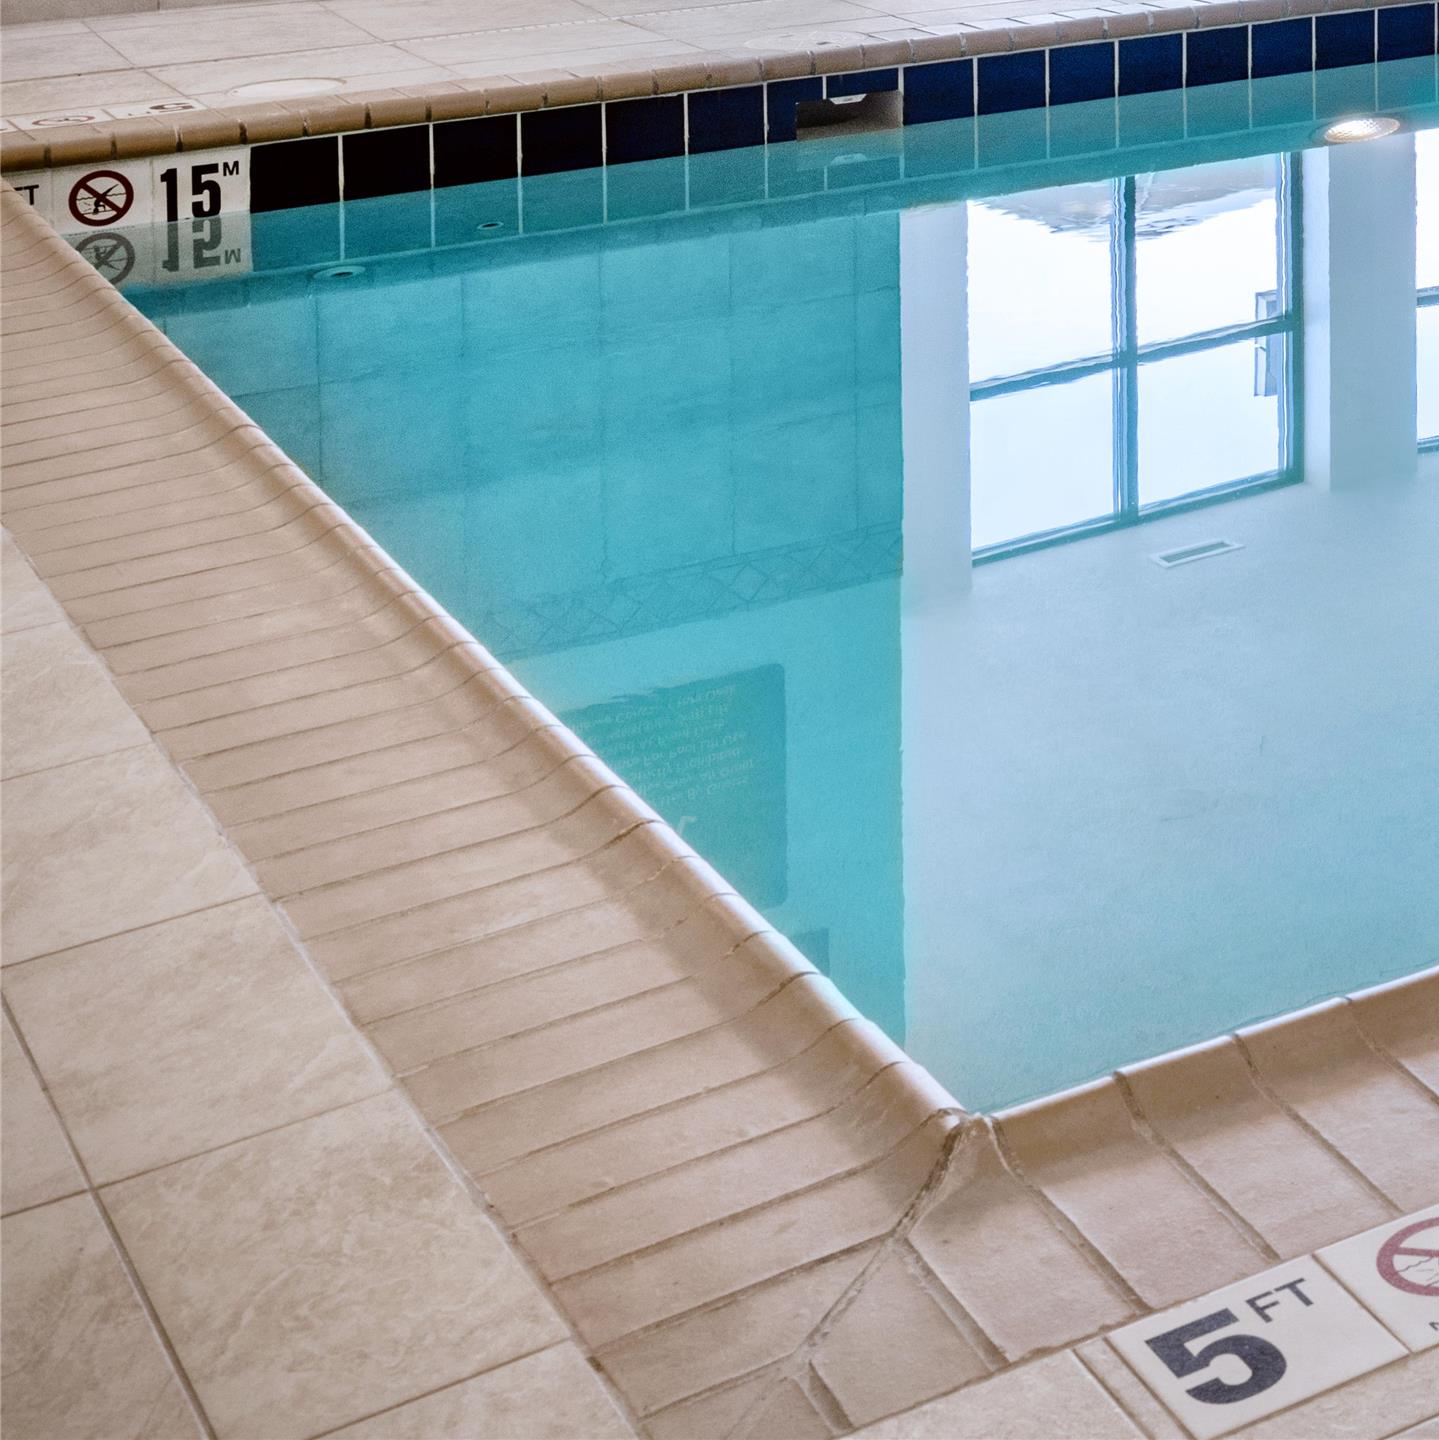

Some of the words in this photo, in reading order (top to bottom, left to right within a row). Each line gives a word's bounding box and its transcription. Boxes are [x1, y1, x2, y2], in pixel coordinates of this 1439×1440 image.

[223, 160, 239, 176] M
[1145, 1307, 1288, 1406] 5
[1245, 1276, 1315, 1323] FT
